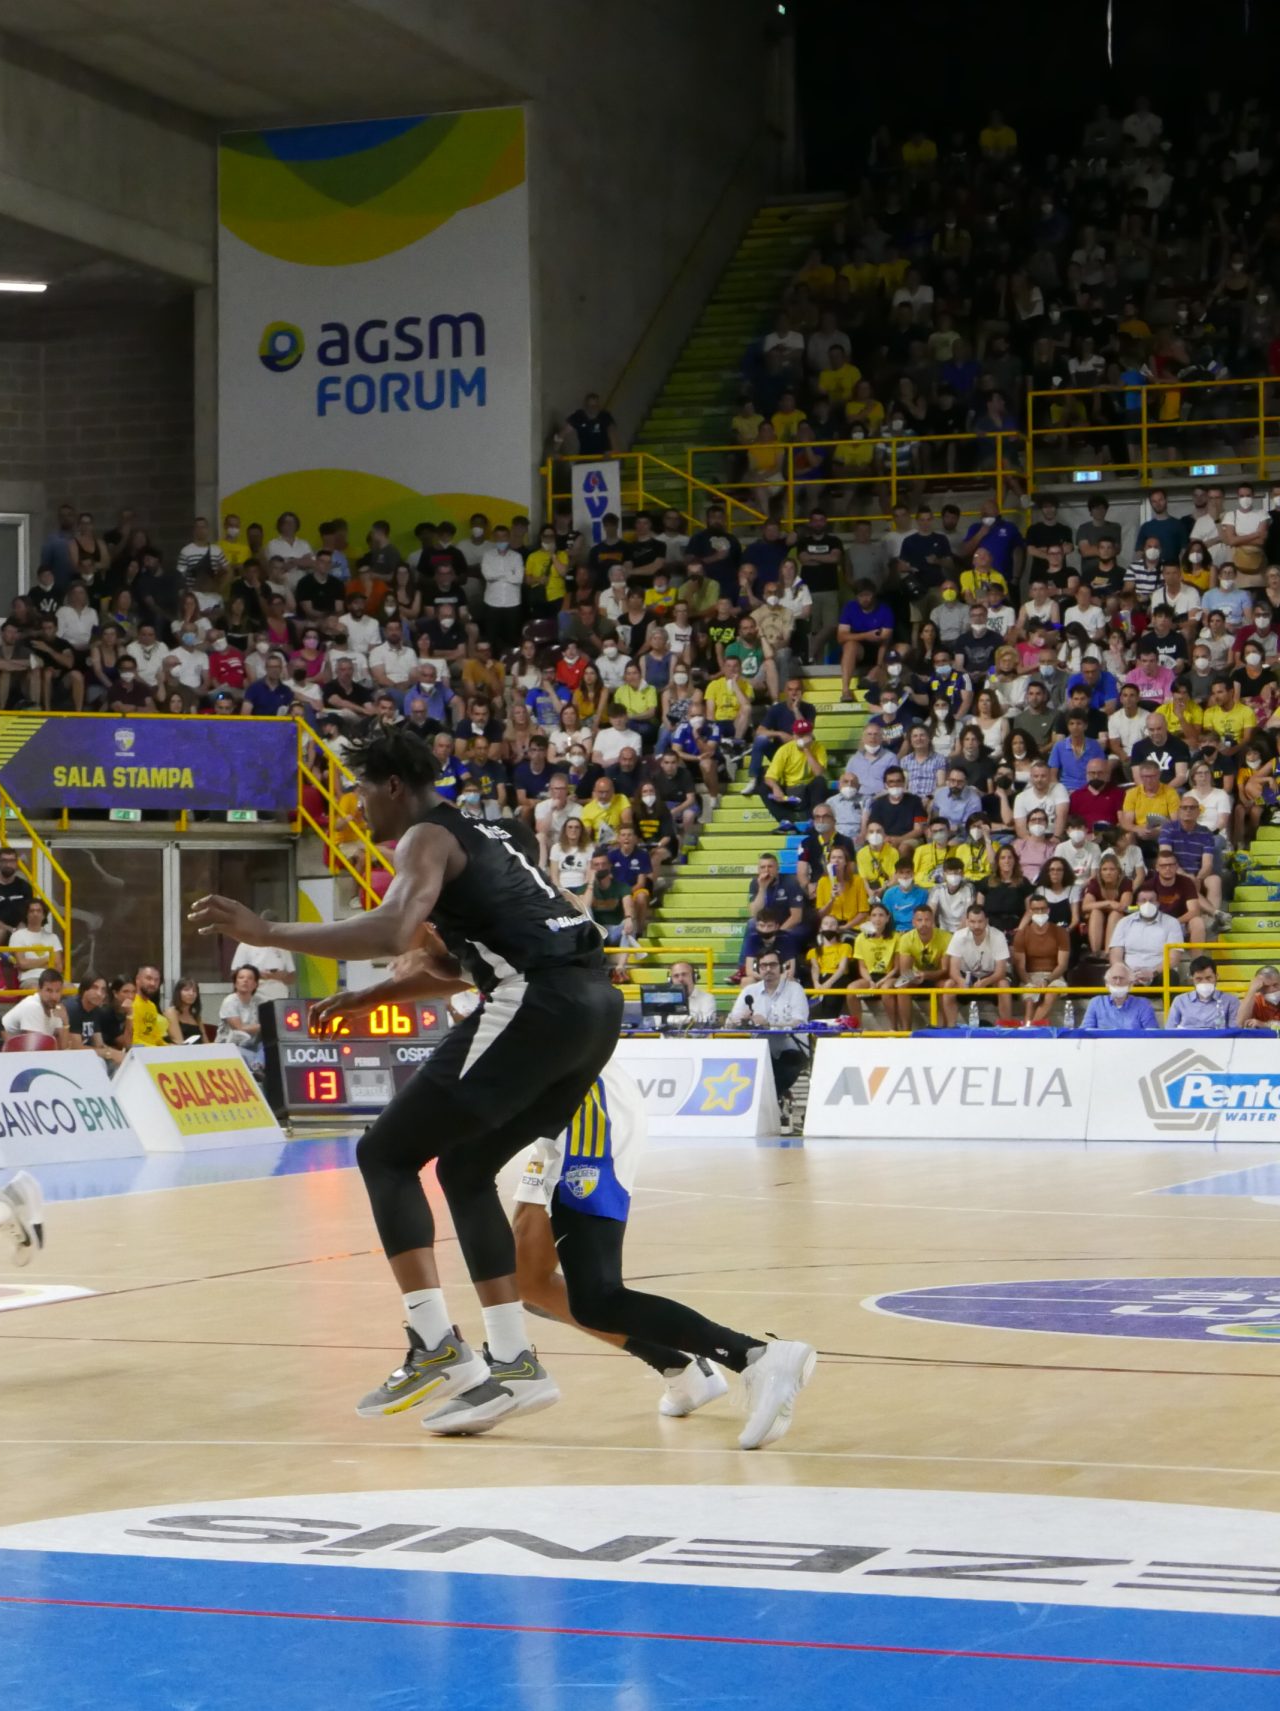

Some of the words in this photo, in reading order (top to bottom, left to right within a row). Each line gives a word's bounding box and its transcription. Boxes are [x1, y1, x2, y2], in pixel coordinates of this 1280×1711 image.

[317, 367, 487, 416] FORUM
[53, 765, 107, 788] SALA
[113, 766, 195, 789] STAMPA
[286, 1048, 339, 1063] LOCALI
[157, 1068, 260, 1110] GALASSIA
[308, 1071, 338, 1099] 13
[888, 1066, 1073, 1108] AVELIA
[73, 1095, 131, 1131] BPM
[1225, 1112, 1278, 1122] WATER
